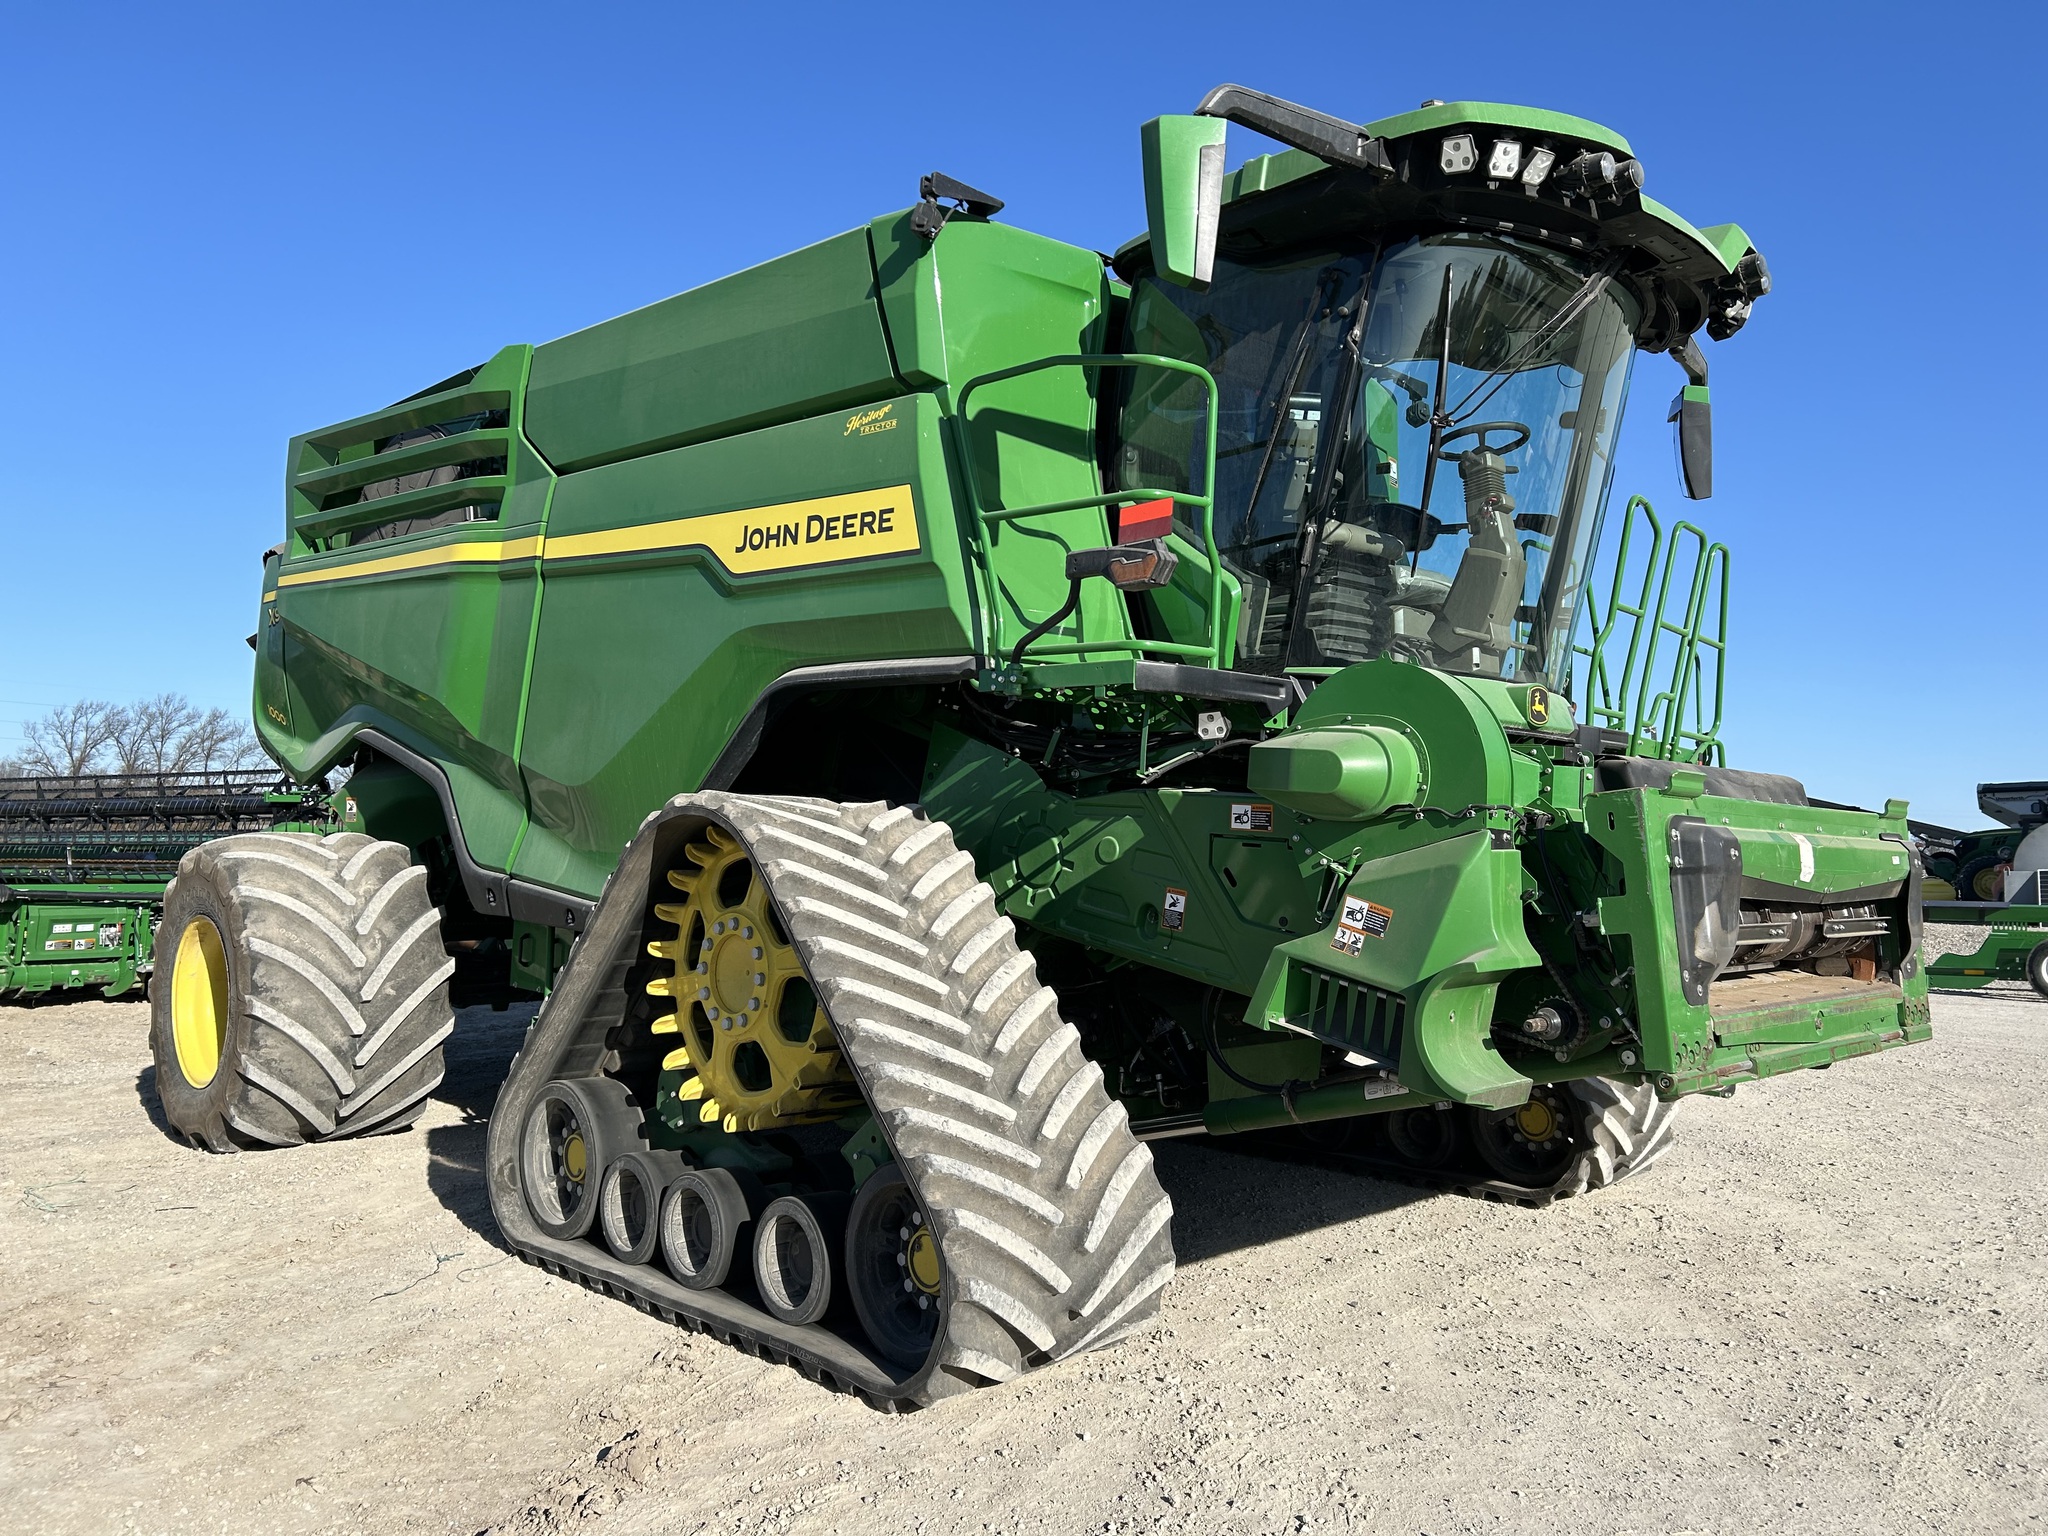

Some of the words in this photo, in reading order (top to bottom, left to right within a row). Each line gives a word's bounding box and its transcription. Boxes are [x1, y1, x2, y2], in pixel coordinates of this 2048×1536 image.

[844, 404, 892, 436] Heritage
[860, 420, 897, 434] TRACTOR
[735, 522, 799, 553] JOHN
[806, 507, 895, 544] DEERE
[267, 704, 287, 726] 1000
